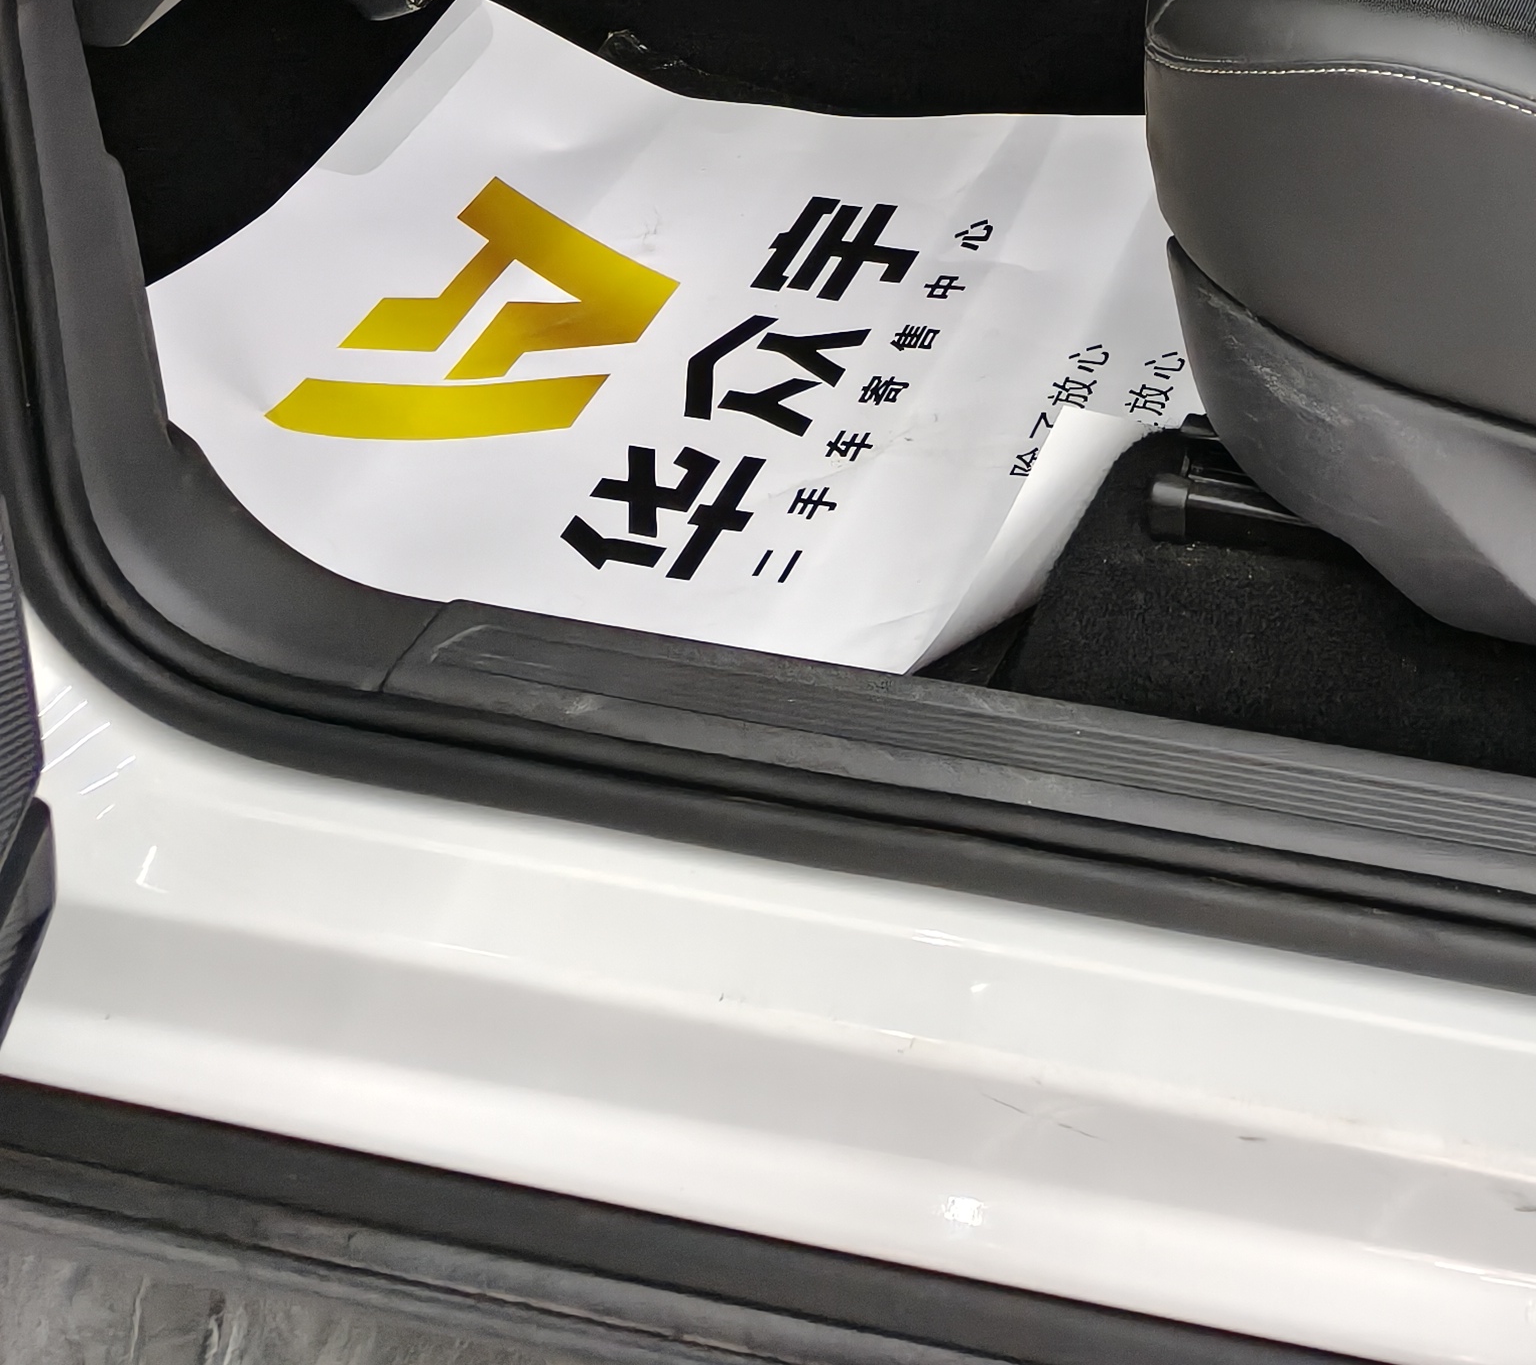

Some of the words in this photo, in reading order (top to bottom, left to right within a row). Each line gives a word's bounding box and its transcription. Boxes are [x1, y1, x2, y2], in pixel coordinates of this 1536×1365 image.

[560, 196, 920, 582] 华众宇
[751, 218, 995, 584] 二手车寄售中心
